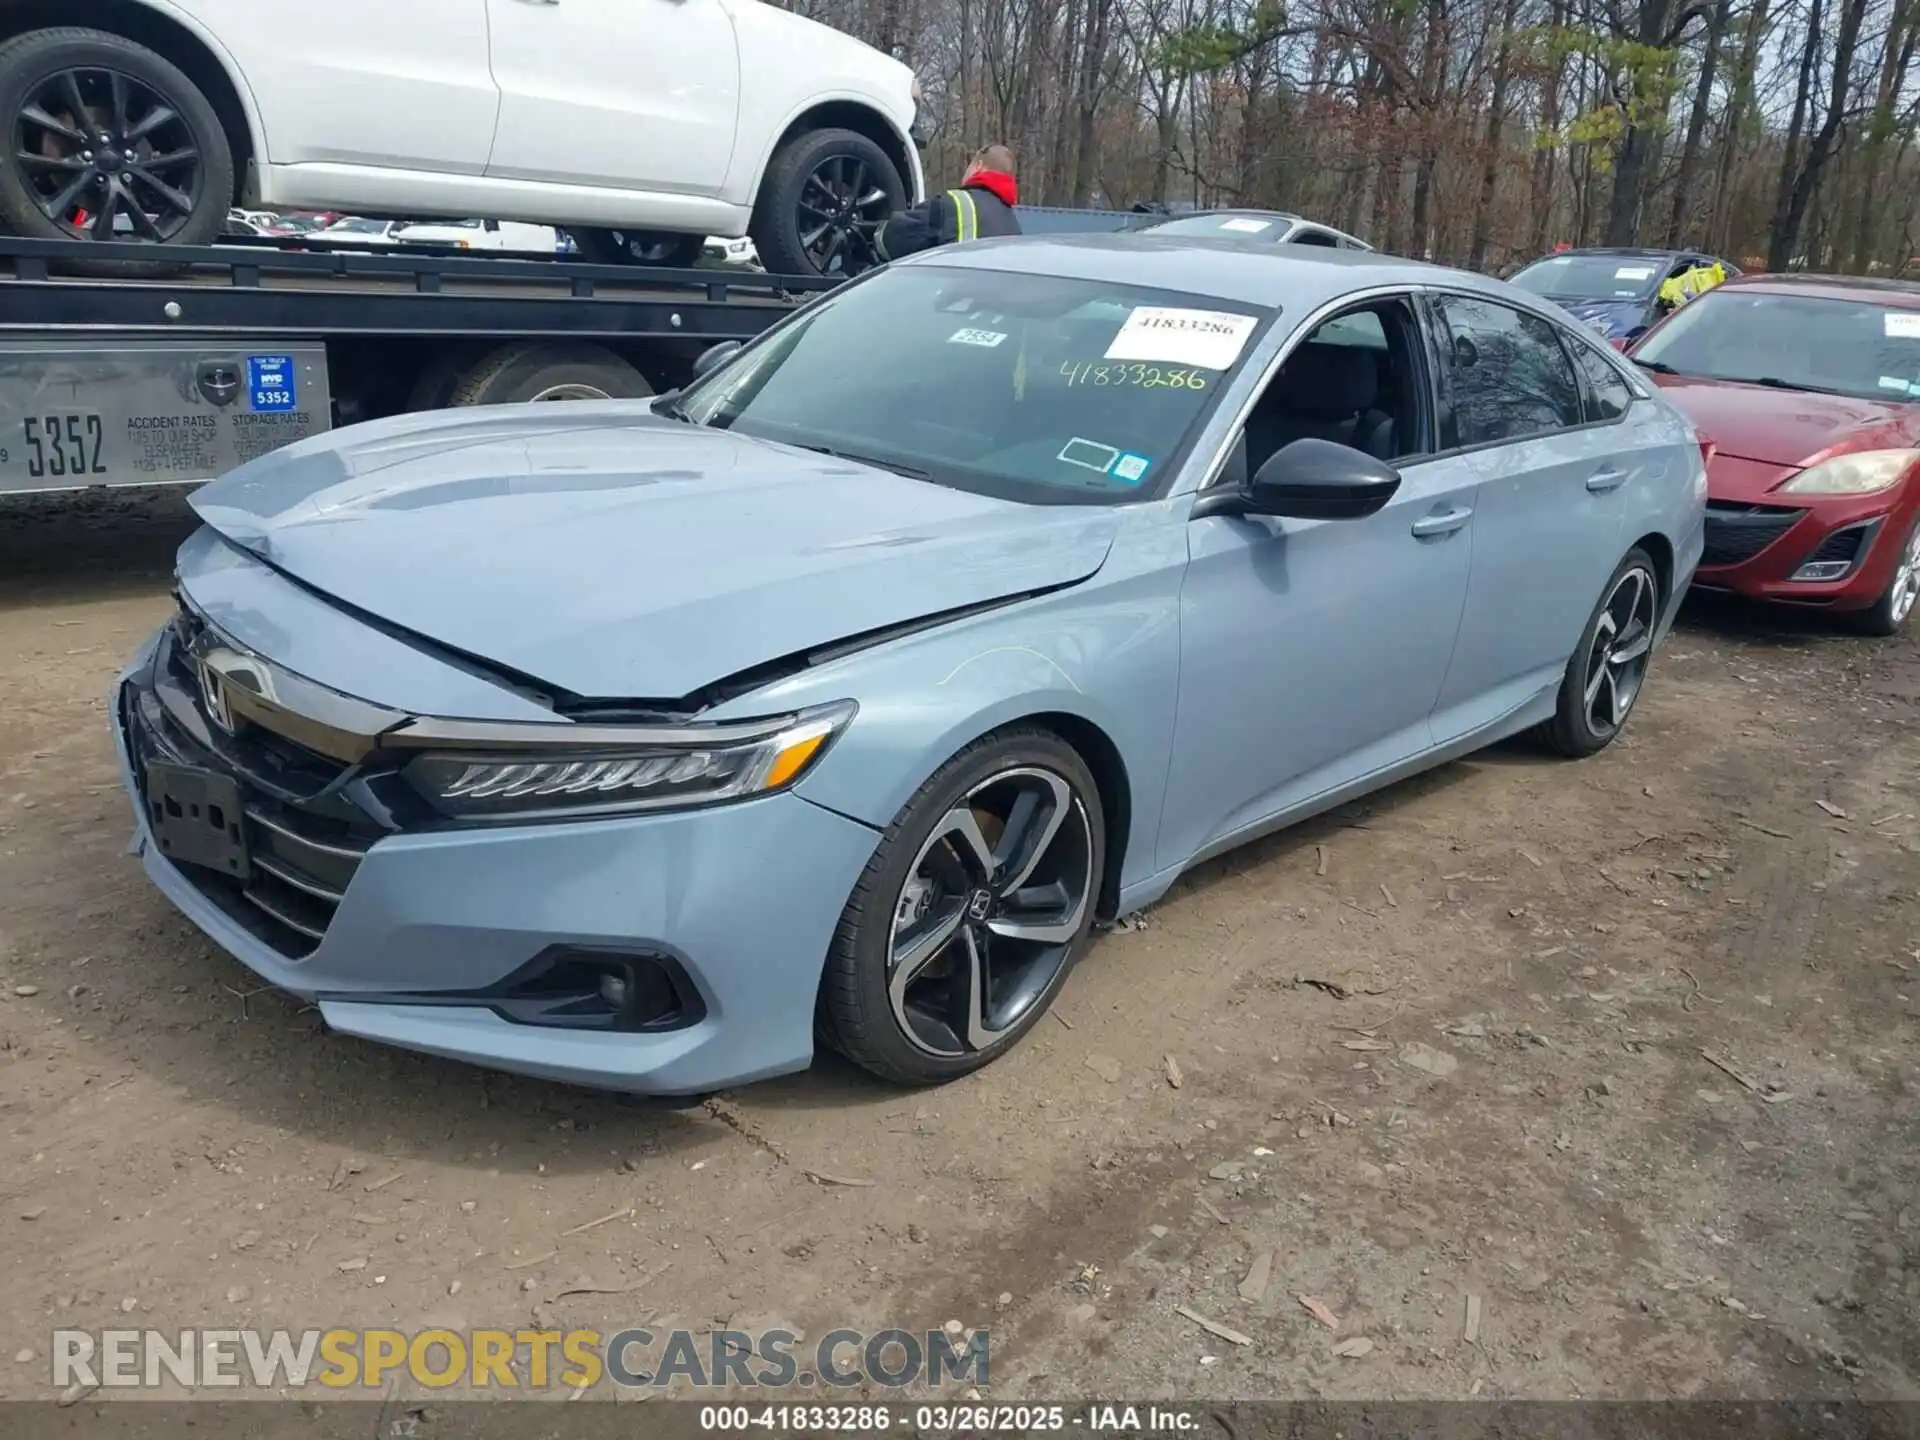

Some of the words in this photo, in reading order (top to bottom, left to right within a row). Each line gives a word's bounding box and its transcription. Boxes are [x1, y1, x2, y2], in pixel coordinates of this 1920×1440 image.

[1060, 359, 1206, 389] 41833286
[256, 391, 290, 404] 5352
[127, 416, 180, 429] ACCIDENT
[182, 414, 217, 427] RATES
[231, 413, 278, 426] STORAGE
[279, 411, 311, 424] RATES
[24, 414, 106, 477] 5352
